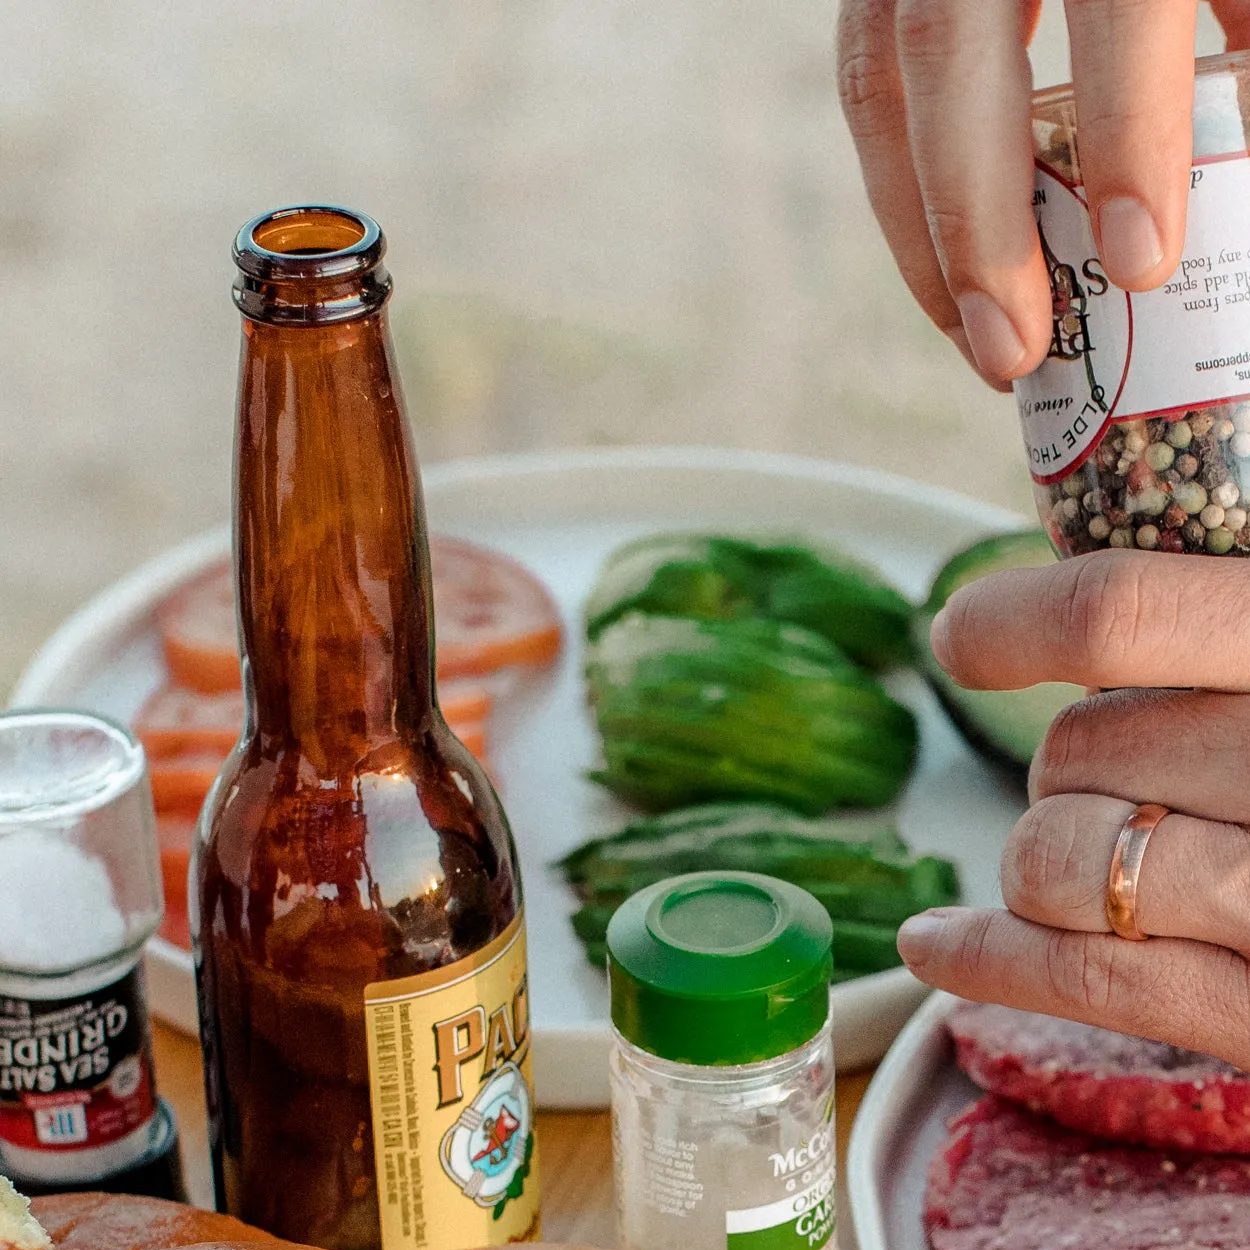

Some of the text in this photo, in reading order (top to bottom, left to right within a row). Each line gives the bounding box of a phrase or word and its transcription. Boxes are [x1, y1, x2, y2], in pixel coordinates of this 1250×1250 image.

[1181, 256, 1212, 275] food
[1217, 248, 1241, 264] any
[1164, 274, 1198, 296] spice
[1204, 276, 1229, 293] add
[1183, 296, 1219, 312] from
[1035, 396, 1073, 416] since
[1062, 385, 1105, 450] OLDE
[60, 1045, 110, 1084] SEA
[0, 1063, 57, 1092] SALT
[674, 1160, 695, 1172] any
